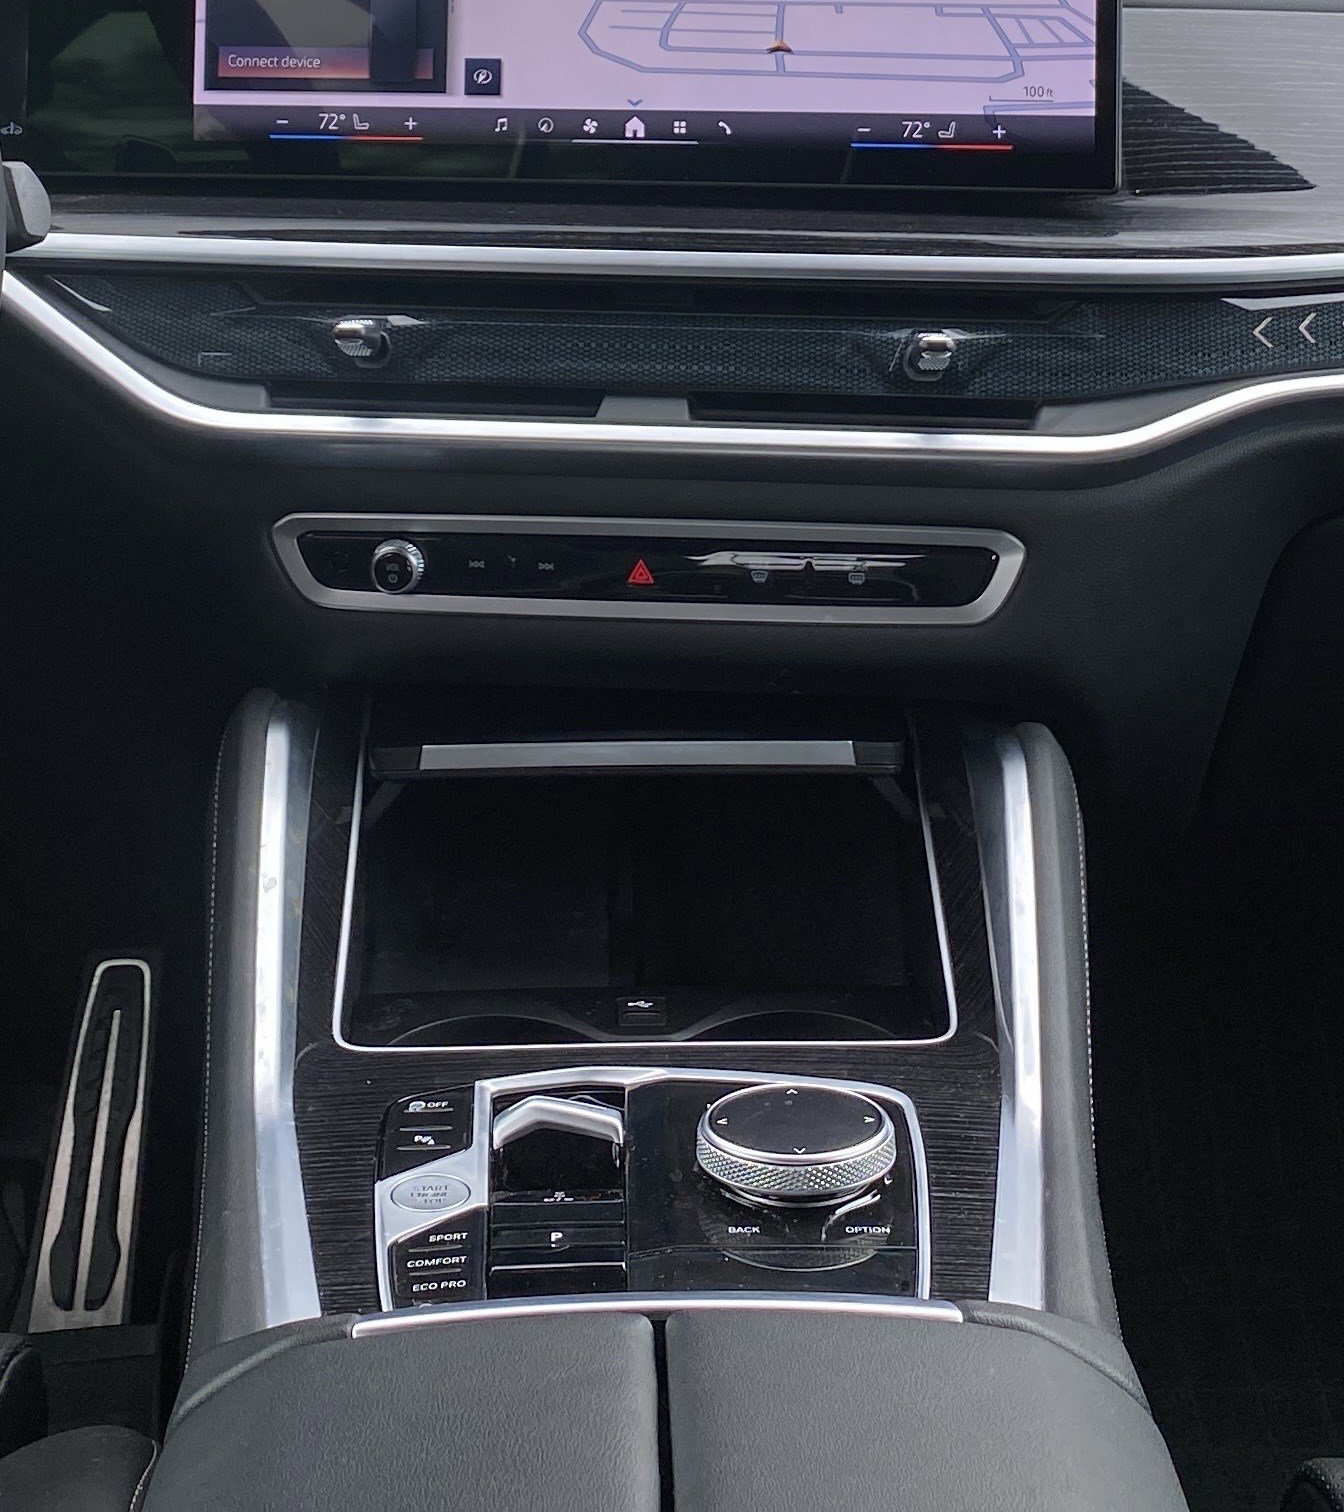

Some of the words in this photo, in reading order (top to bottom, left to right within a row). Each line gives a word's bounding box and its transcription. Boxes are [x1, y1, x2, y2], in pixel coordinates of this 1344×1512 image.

[228, 54, 279, 68] Connect
[281, 55, 321, 68] device
[1022, 86, 1045, 98] 100
[1046, 87, 1054, 98] ft
[318, 113, 346, 130] 72°
[902, 121, 931, 138] 72°
[728, 1226, 761, 1234] BACK
[845, 1226, 891, 1234] OPTION
[428, 1232, 468, 1243] SPORT
[550, 1232, 563, 1242] P
[407, 1256, 467, 1268] COMFORT
[412, 1282, 438, 1292] ECO
[441, 1279, 467, 1289] PRO
